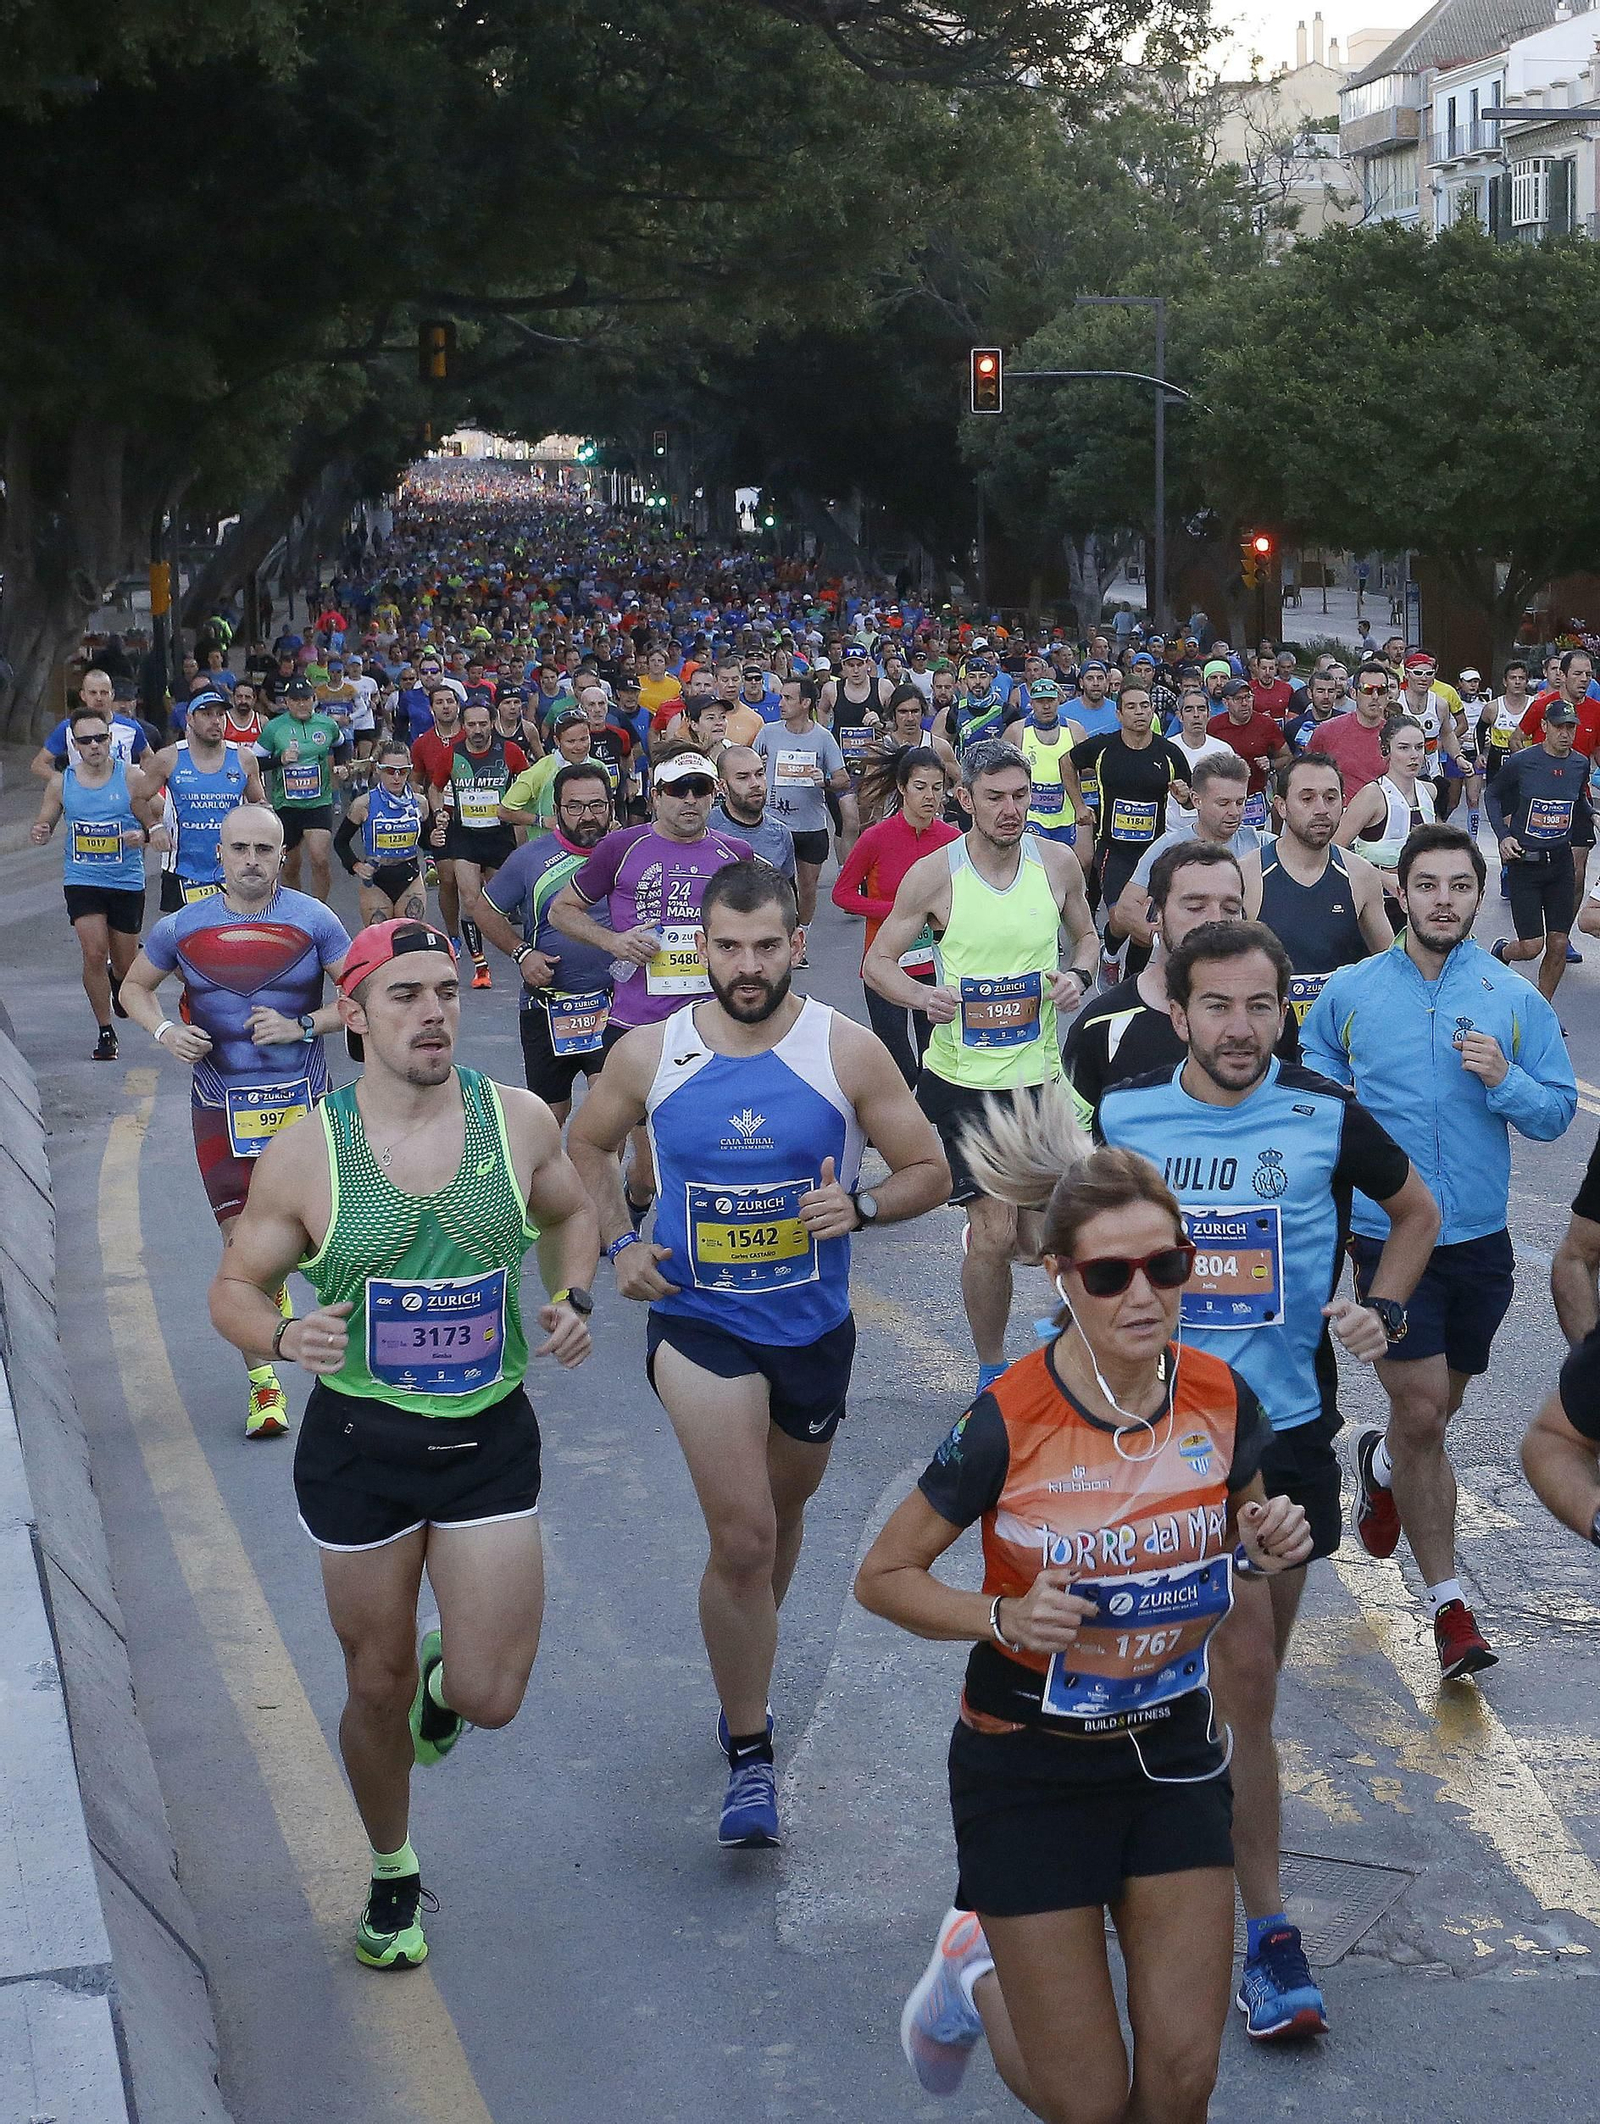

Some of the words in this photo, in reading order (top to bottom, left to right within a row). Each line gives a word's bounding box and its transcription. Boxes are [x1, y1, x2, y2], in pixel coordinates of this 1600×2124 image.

[477, 777, 506, 787] MTEZ
[180, 793, 200, 801] CLUB
[87, 839, 106, 847] 1017
[388, 834, 408, 844] 1234
[667, 881, 692, 901] 24
[669, 953, 700, 966] 5480
[993, 981, 1027, 993] ZURICH
[573, 999, 599, 1009] ZURICH
[986, 1002, 1021, 1018] 1942
[569, 1015, 597, 1029] 2180
[263, 1091, 295, 1101] ZURICH
[259, 1112, 286, 1126] 997
[736, 1196, 786, 1211] ZURICH
[1193, 1223, 1248, 1235] ZURICH
[726, 1226, 780, 1249] 1542
[1194, 1254, 1240, 1278] 804
[426, 1290, 482, 1308] ZURICH
[411, 1324, 473, 1348] 3173
[1143, 1516, 1181, 1555] del
[1138, 1584, 1199, 1610] ZURICH
[1115, 1627, 1184, 1660] 1767
